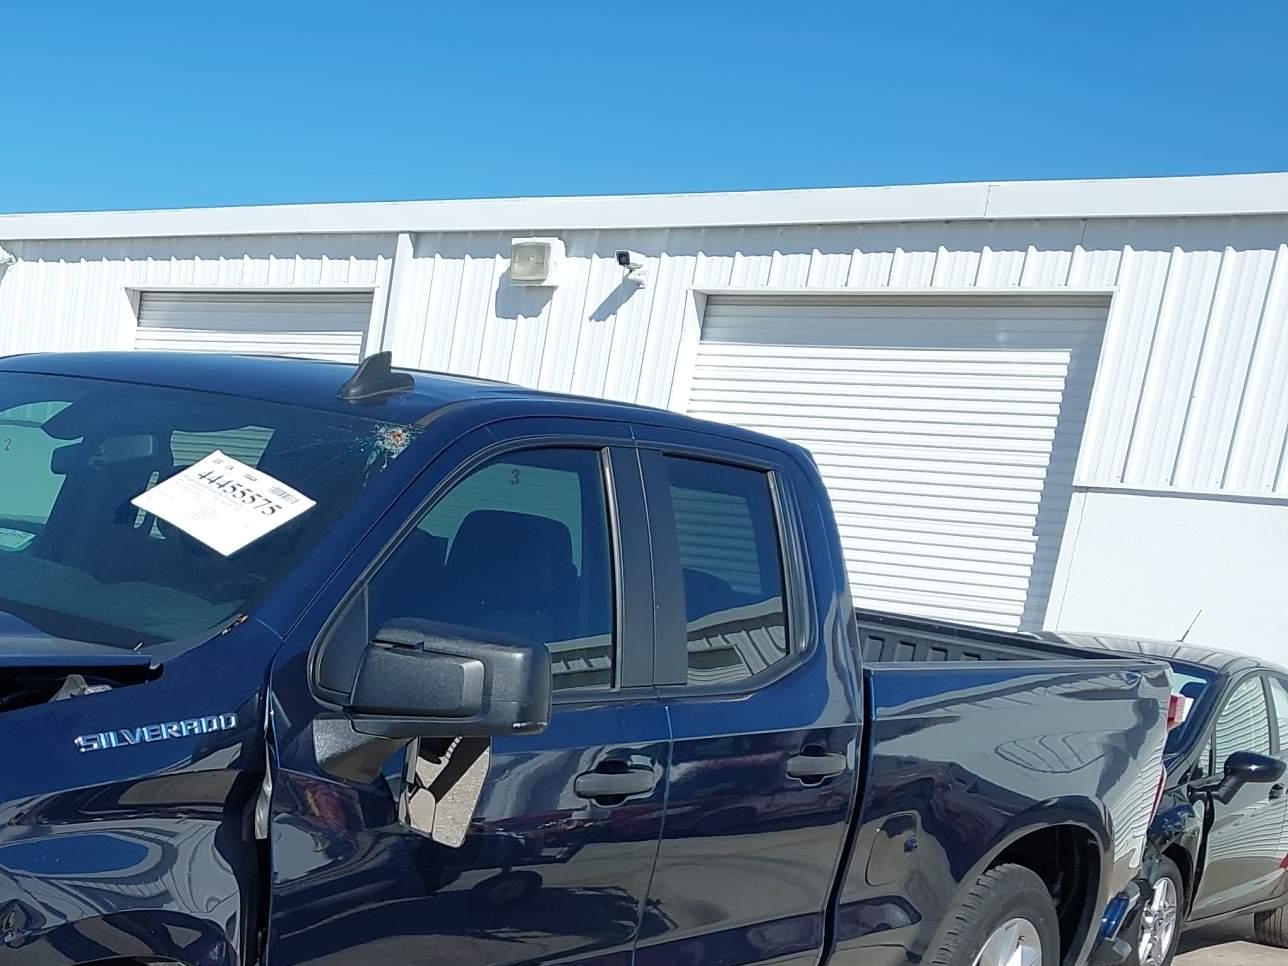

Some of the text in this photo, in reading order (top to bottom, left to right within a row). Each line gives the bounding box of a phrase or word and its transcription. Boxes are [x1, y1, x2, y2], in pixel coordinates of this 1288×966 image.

[4, 438, 12, 451] 2
[511, 469, 520, 485] 3
[197, 470, 283, 516] 44455575
[74, 712, 239, 753] SILVERADO
